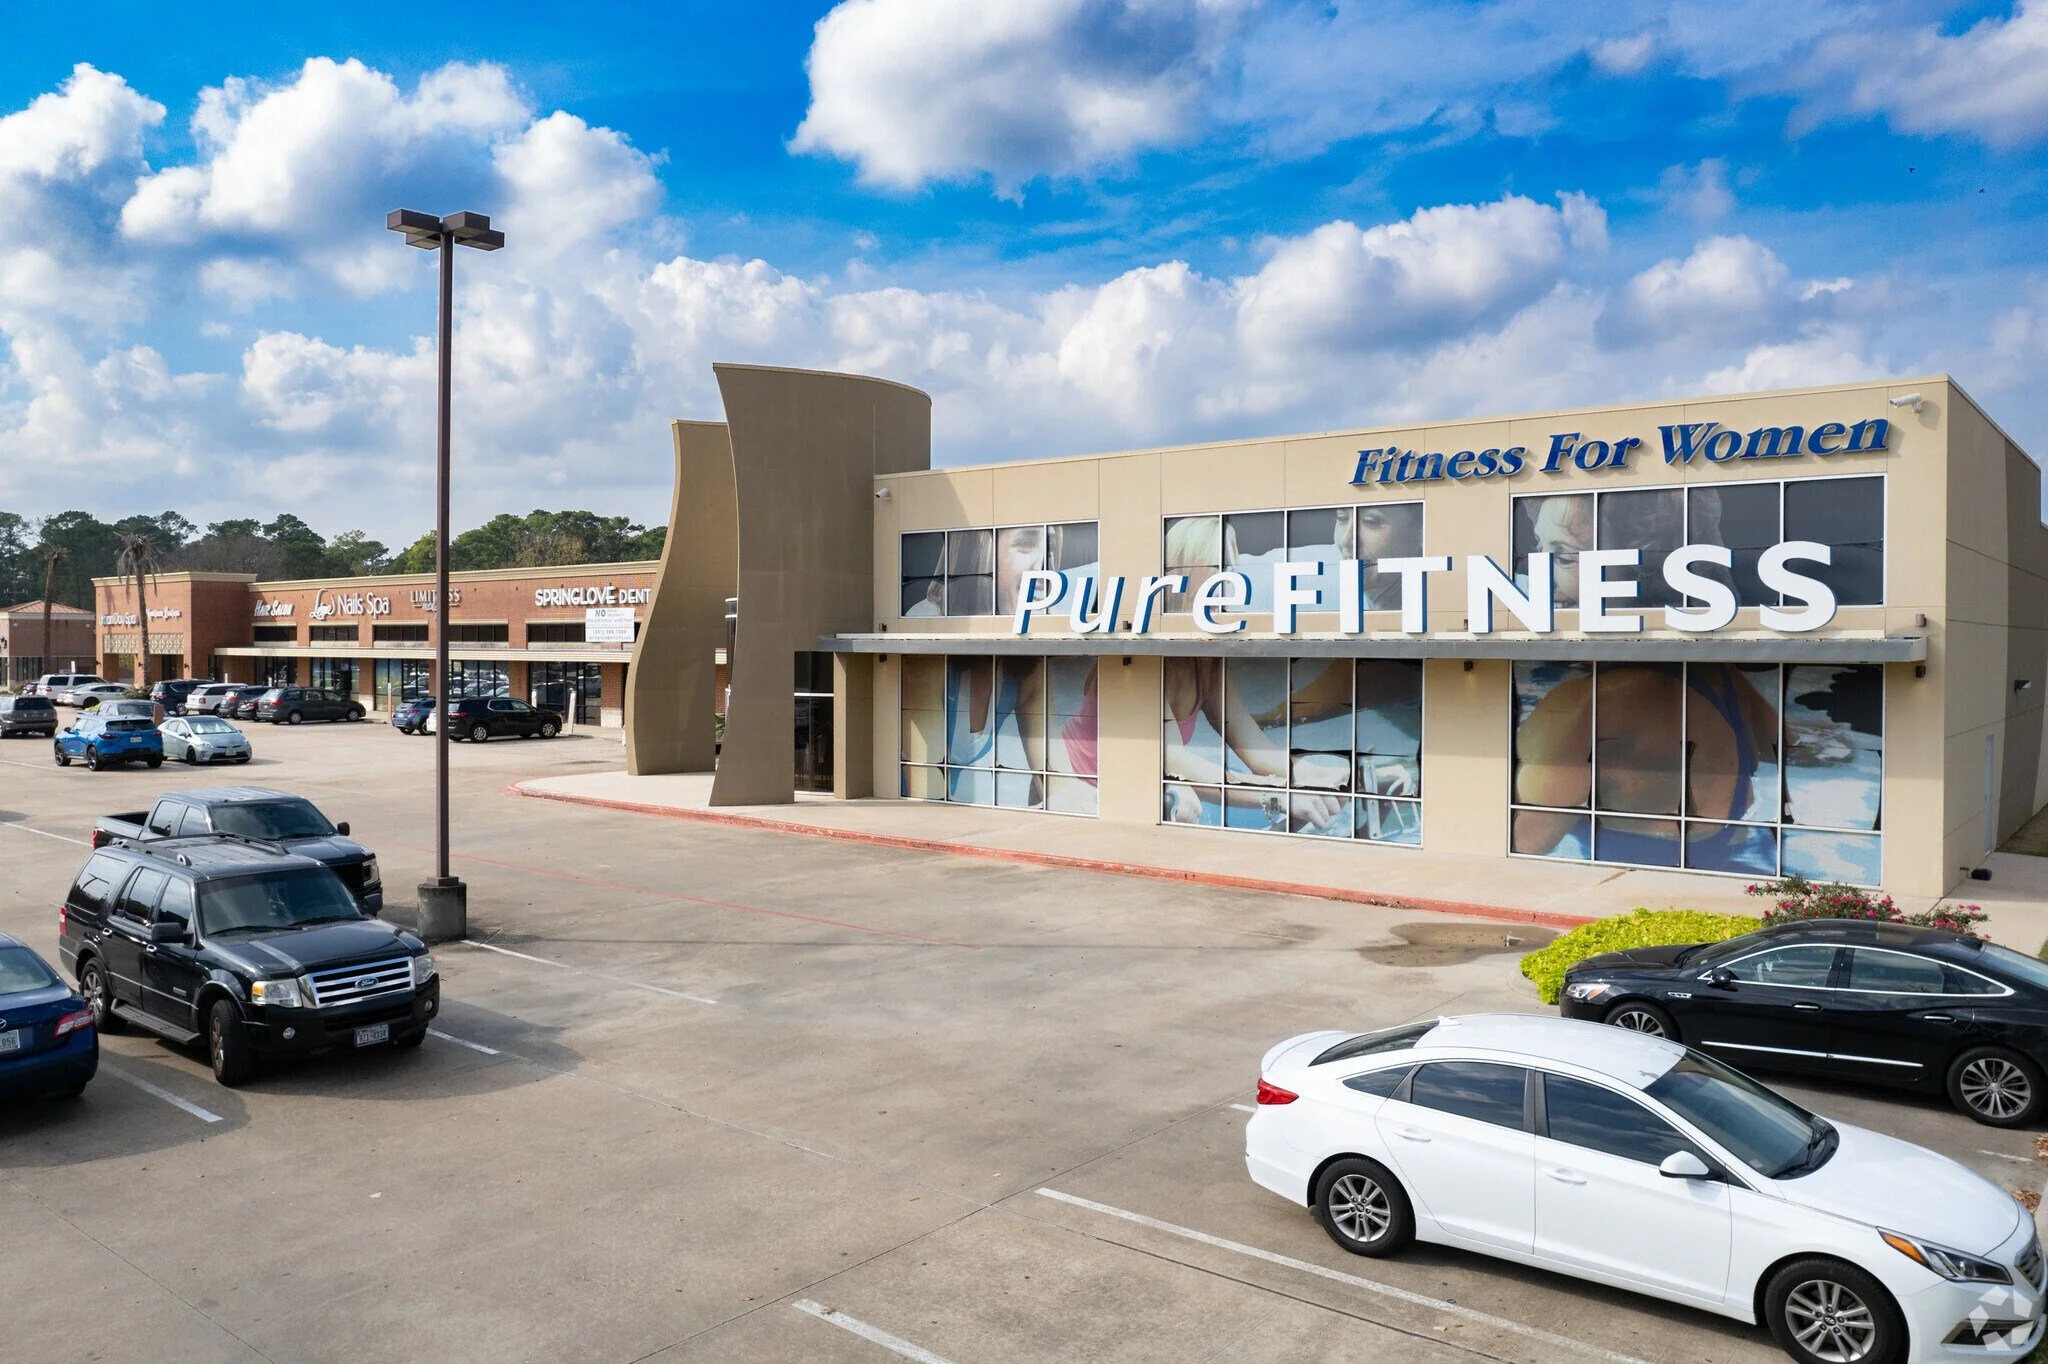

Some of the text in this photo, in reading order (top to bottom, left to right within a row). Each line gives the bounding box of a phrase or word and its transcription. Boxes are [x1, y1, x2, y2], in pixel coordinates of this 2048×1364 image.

[1349, 418, 1891, 486] Fitness For Women
[337, 592, 363, 615] Nails
[366, 591, 390, 615] Spa
[410, 588, 460, 603] LIMITSS
[535, 586, 617, 607] SPRINGLOVE
[595, 609, 606, 618] NO
